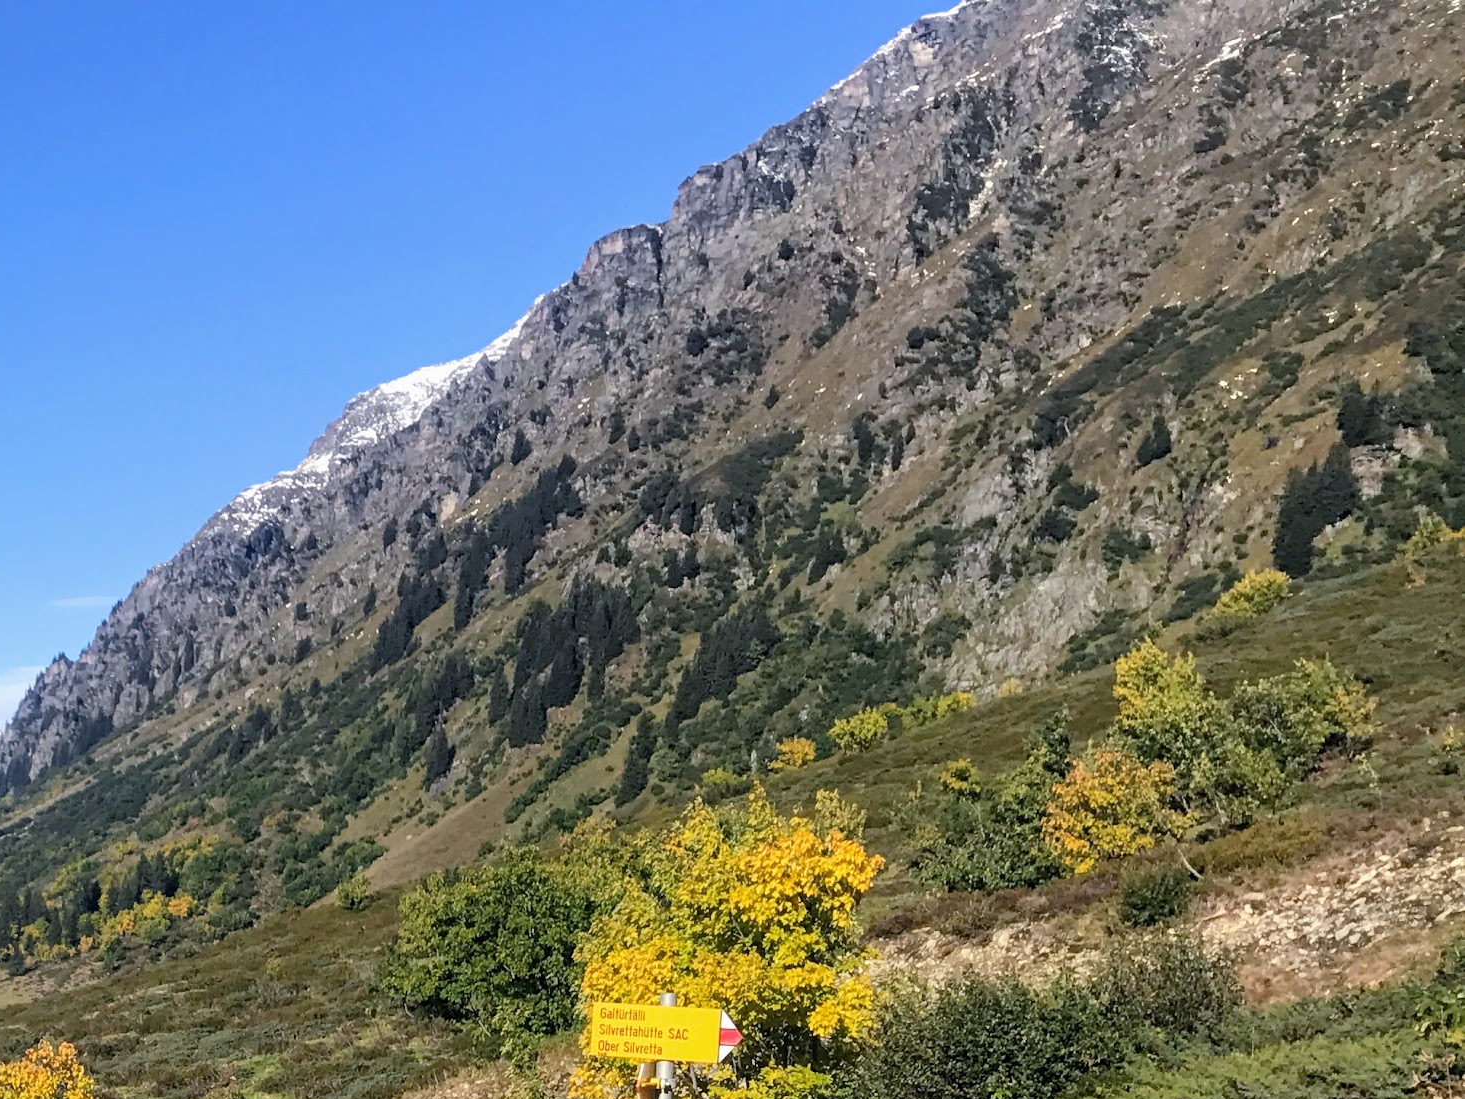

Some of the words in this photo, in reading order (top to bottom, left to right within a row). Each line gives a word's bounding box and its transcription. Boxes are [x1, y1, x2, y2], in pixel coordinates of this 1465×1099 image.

[599, 1023, 663, 1039] Silvrettahütte
[668, 1027, 689, 1041] SAC
[598, 1039, 620, 1052] Ober
[623, 1041, 663, 1056] Silvretta
